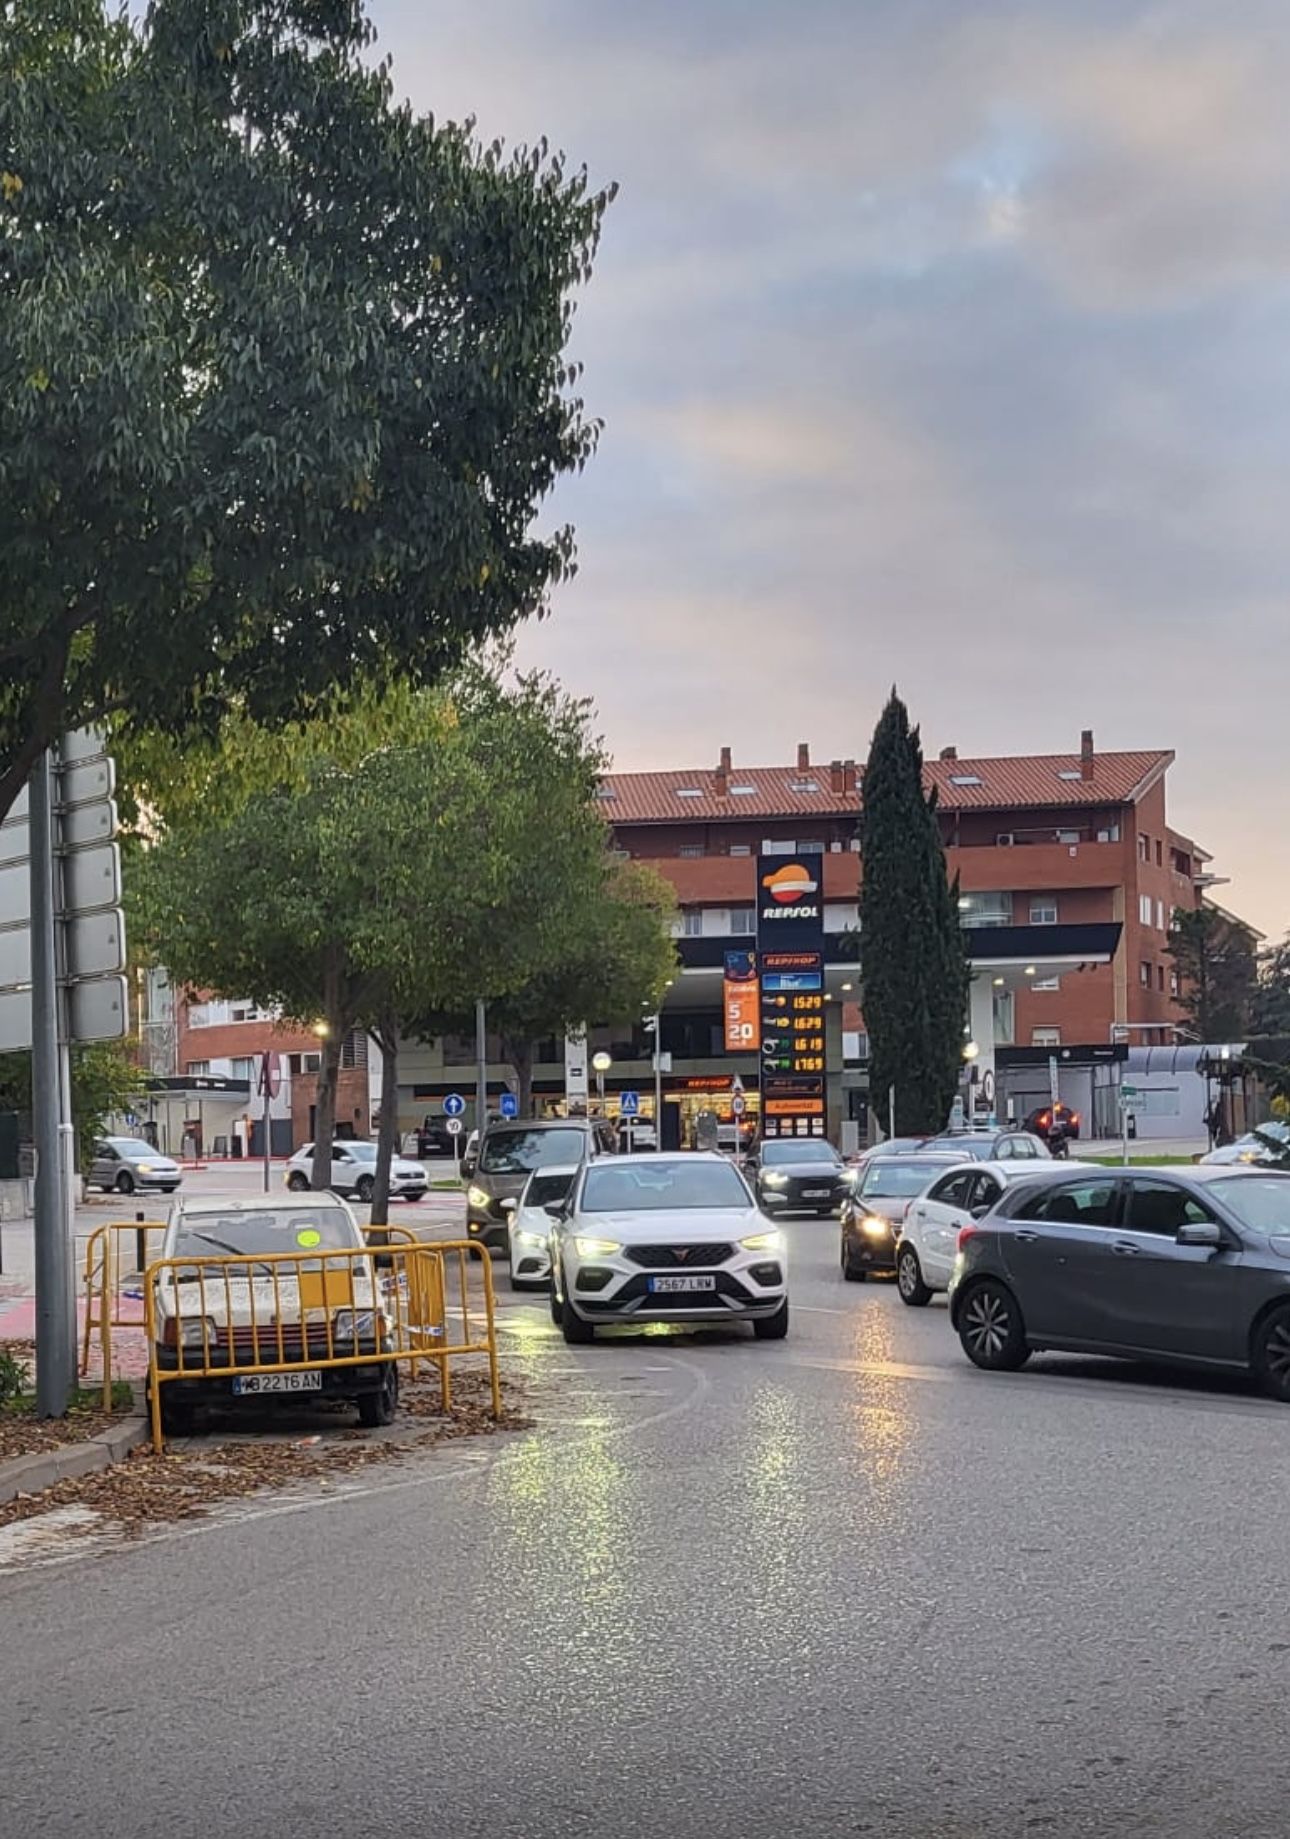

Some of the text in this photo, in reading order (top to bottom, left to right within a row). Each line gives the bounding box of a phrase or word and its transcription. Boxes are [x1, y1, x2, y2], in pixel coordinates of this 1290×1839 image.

[763, 906, 818, 918] REPSOL
[728, 1003, 741, 1019] 5
[729, 1023, 753, 1039] 20
